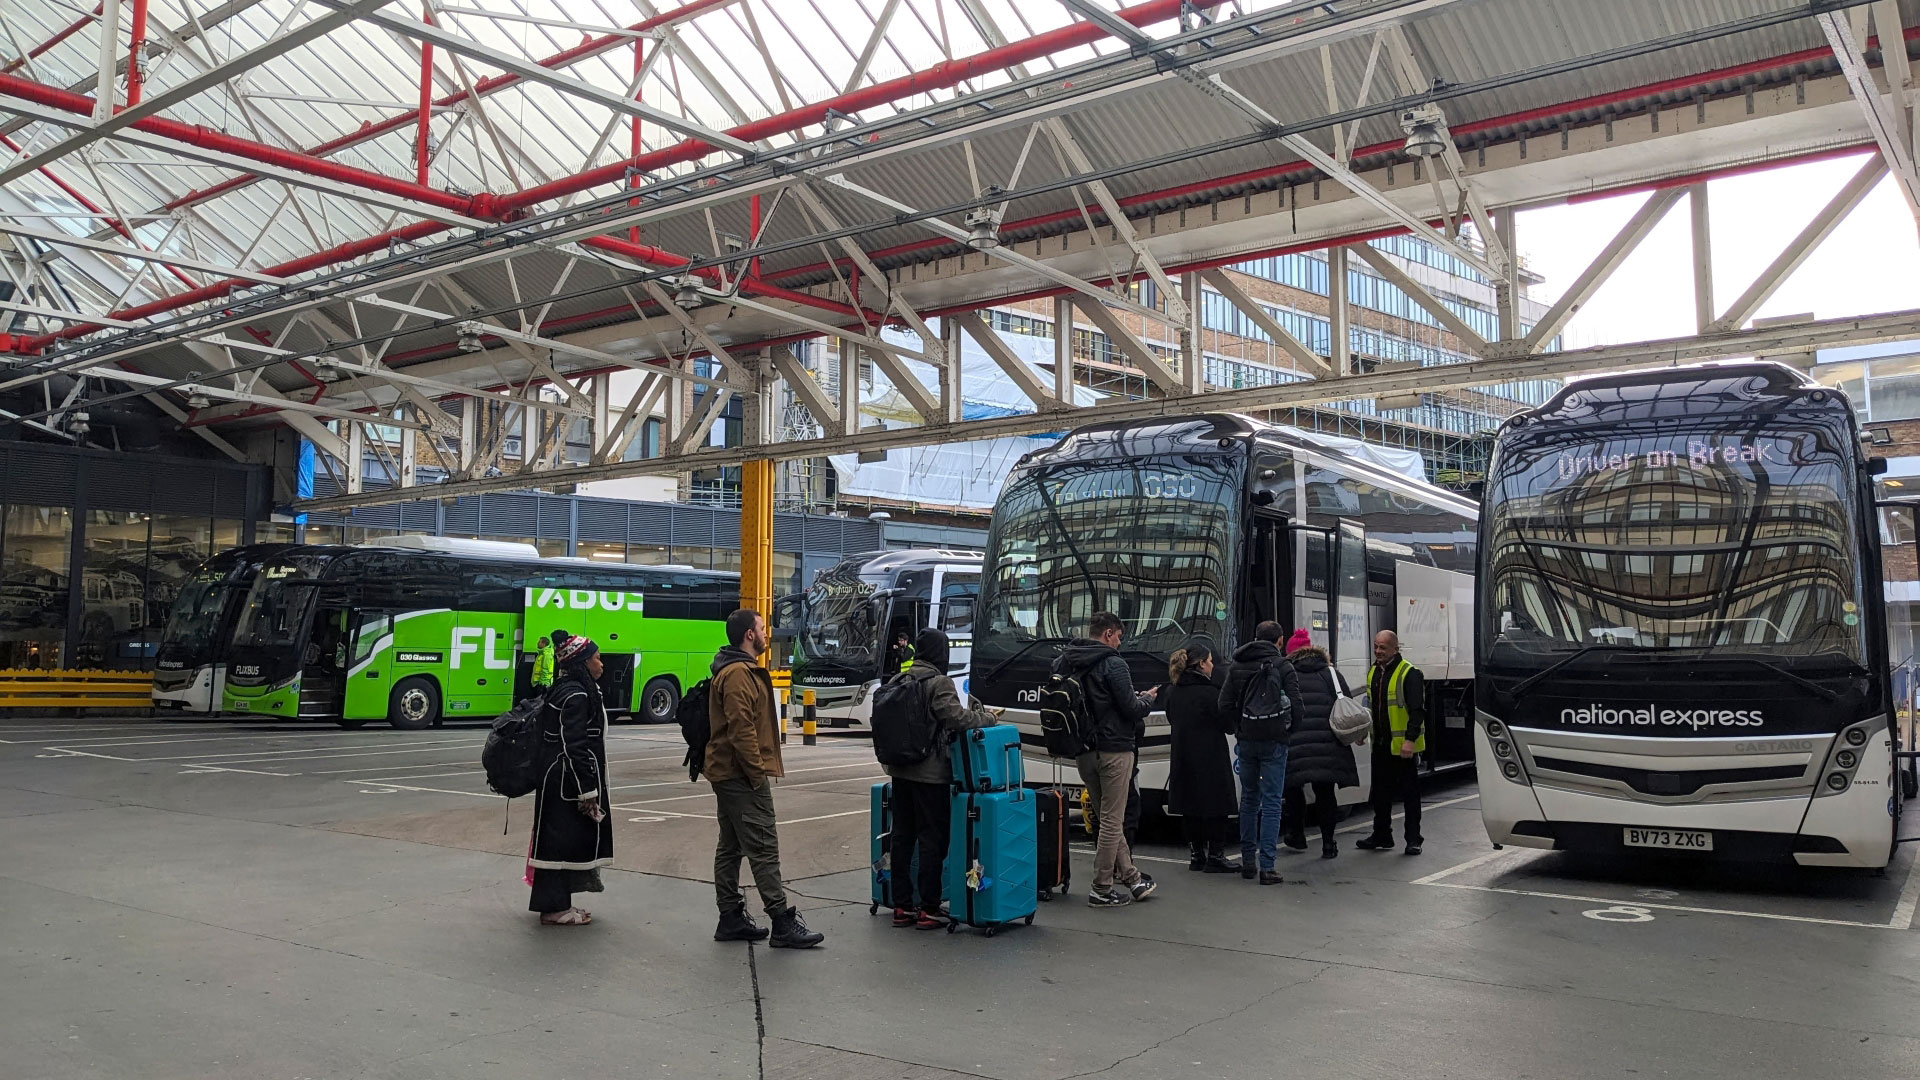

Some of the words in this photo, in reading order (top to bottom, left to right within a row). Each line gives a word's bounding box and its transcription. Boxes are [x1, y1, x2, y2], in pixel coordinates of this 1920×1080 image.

[1558, 450, 1635, 480] Driver
[1646, 449, 1678, 469] on
[1688, 439, 1773, 470] Break
[1560, 703, 1655, 725] national
[1659, 709, 1764, 732] express
[1734, 741, 1813, 753] CAETANO
[1630, 829, 1670, 845] BV73
[1674, 832, 1705, 848] ZXG
[1581, 905, 1656, 922] 8
